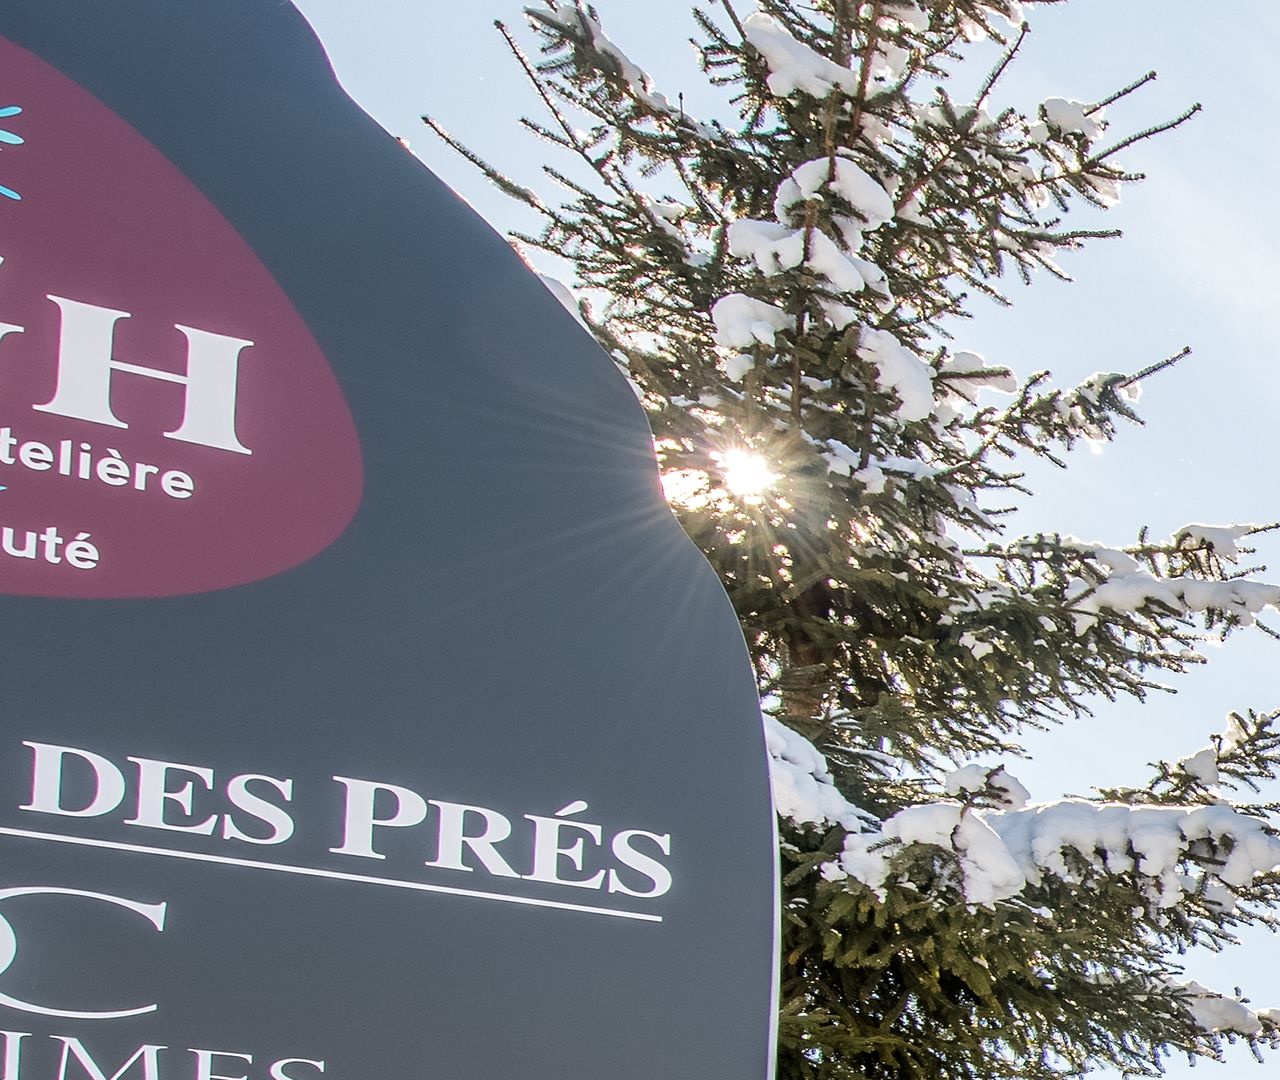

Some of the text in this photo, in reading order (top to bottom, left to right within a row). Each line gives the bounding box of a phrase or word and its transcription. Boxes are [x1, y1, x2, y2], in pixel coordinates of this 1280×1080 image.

[0, 426, 195, 499] telière
[1, 526, 100, 569] uté
[18, 740, 673, 899] DES PRÉS
